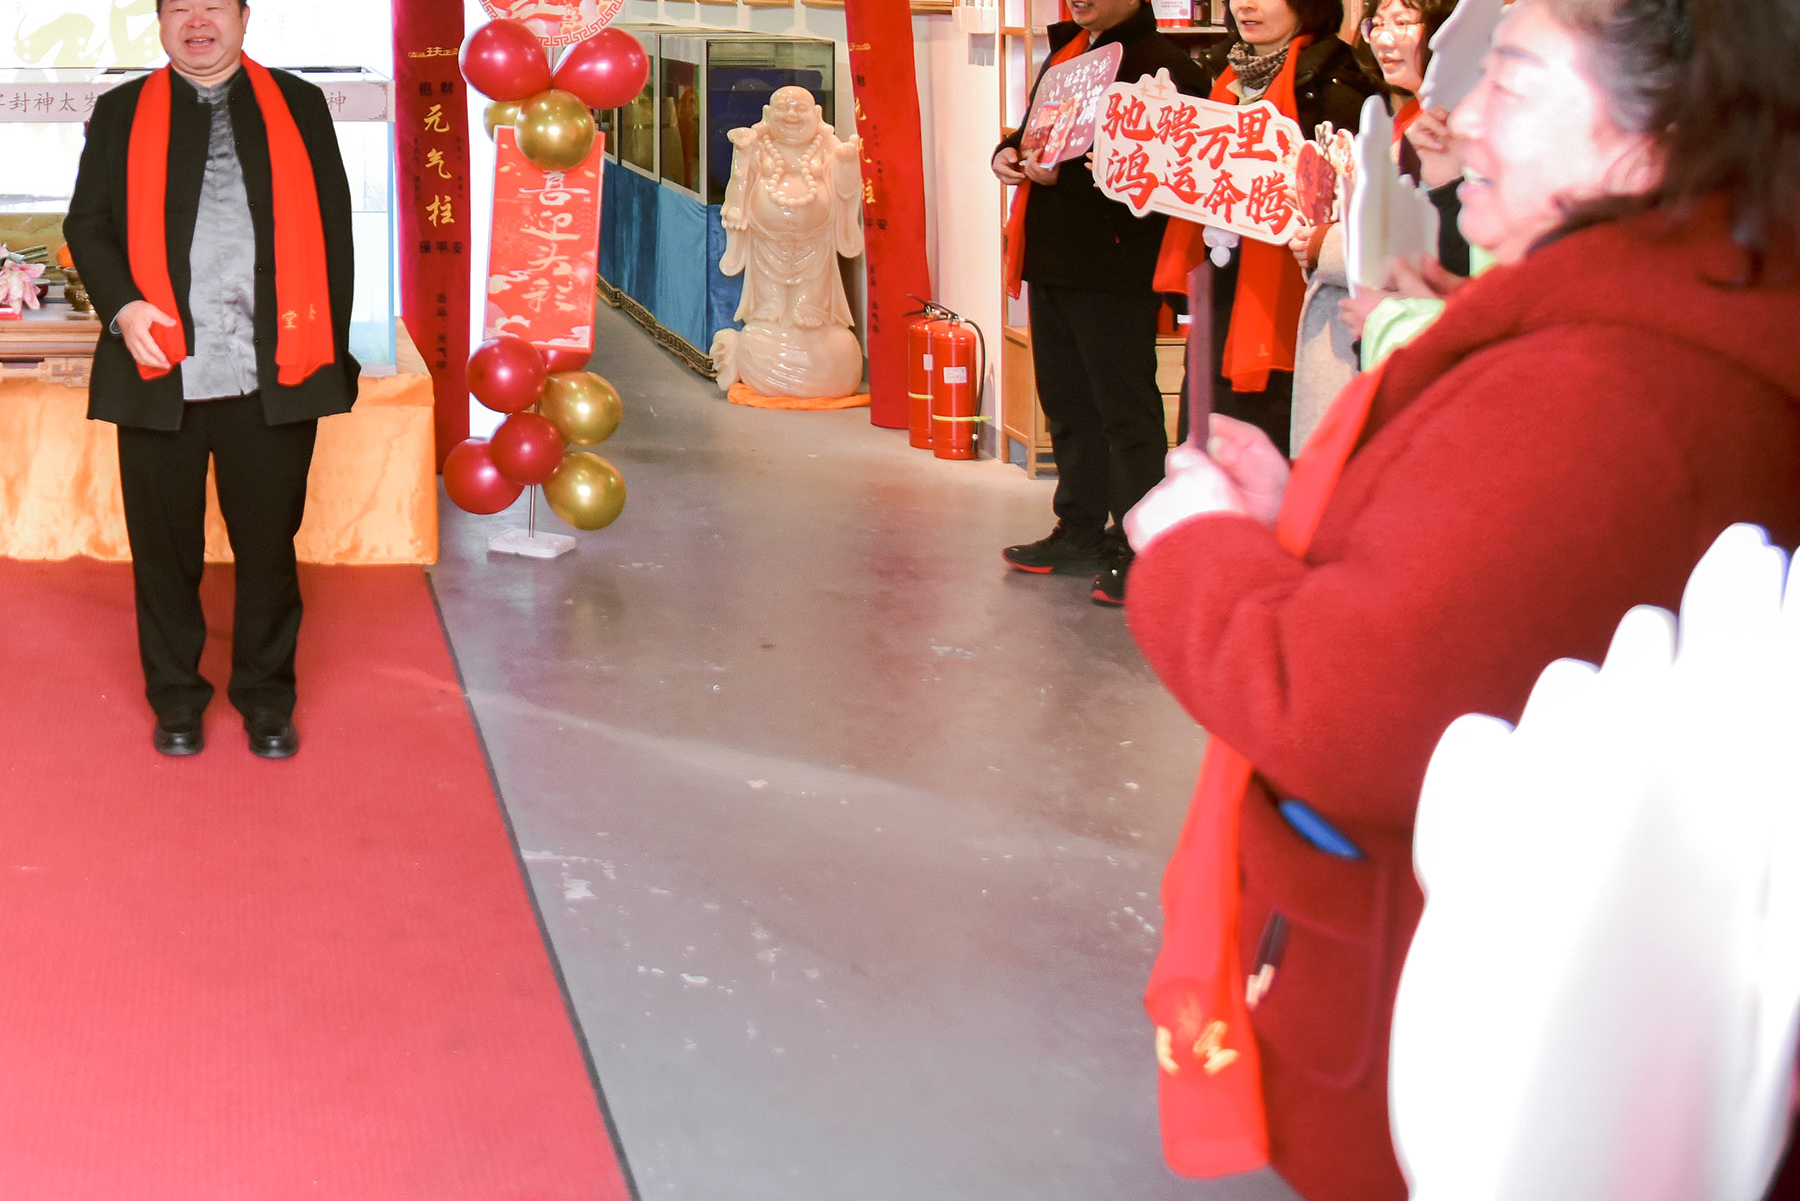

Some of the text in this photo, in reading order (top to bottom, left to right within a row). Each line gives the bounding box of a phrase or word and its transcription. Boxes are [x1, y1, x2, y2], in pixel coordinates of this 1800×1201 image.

[326, 91, 347, 113] 神
[1101, 92, 1278, 165] 驰骋万里
[423, 103, 456, 228] 元气柱
[1105, 142, 1294, 236] 鸿运奔腾
